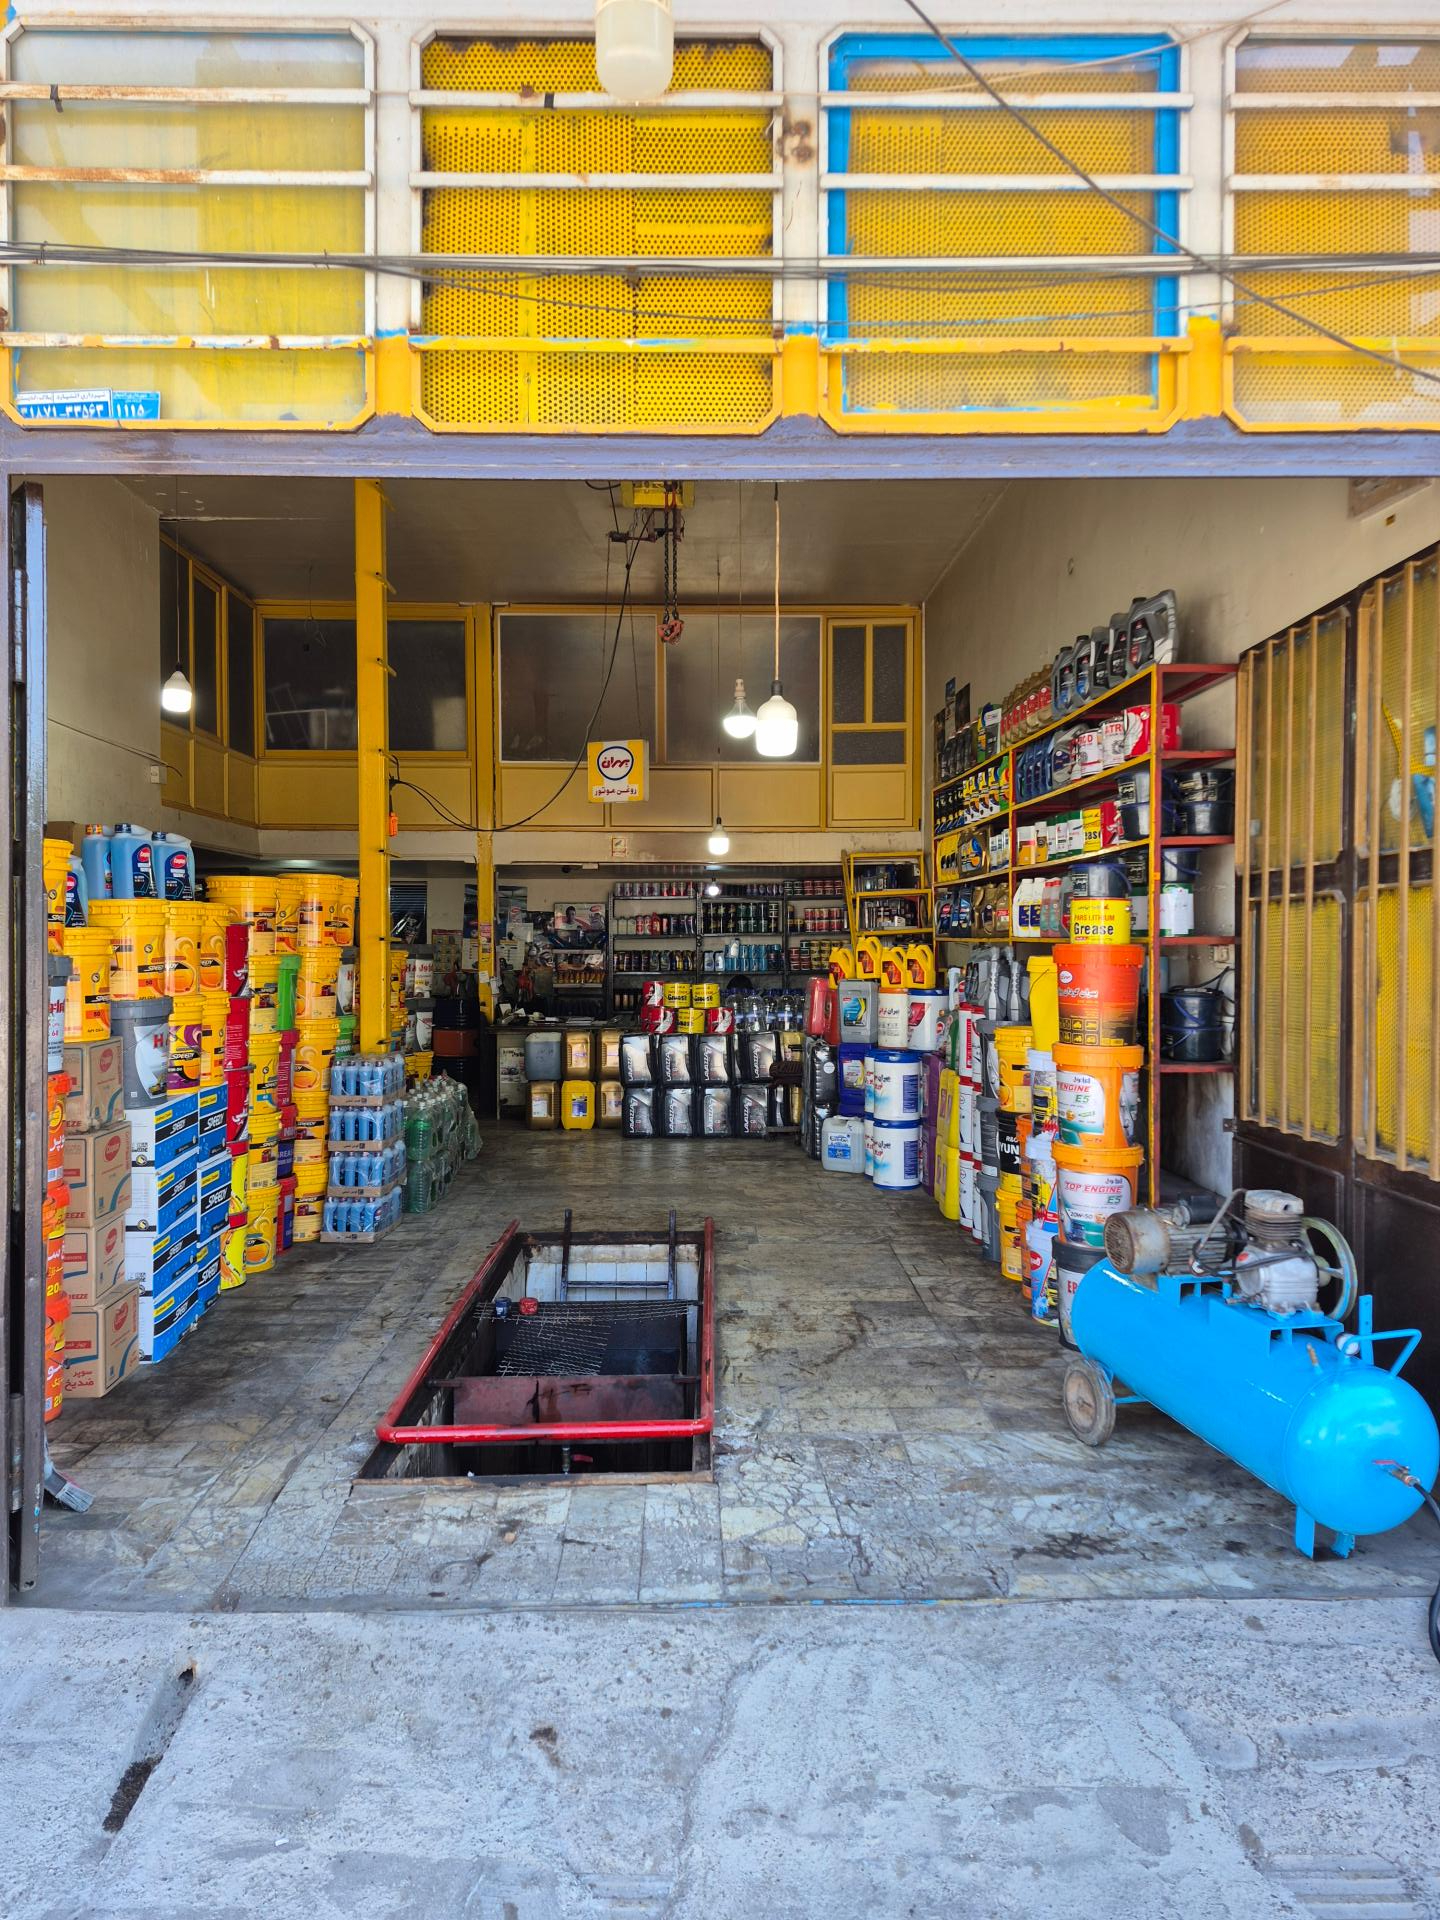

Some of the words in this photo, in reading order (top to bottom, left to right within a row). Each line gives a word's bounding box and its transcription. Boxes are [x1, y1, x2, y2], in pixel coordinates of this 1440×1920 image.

[601, 756, 630, 769] بهران
[594, 786, 616, 796] موتور
[616, 785, 637, 796] روغن
[1074, 922, 1114, 936] Grease
[1064, 1181, 1082, 1193] TOP
[1082, 1186, 1122, 1194] ENGINE
